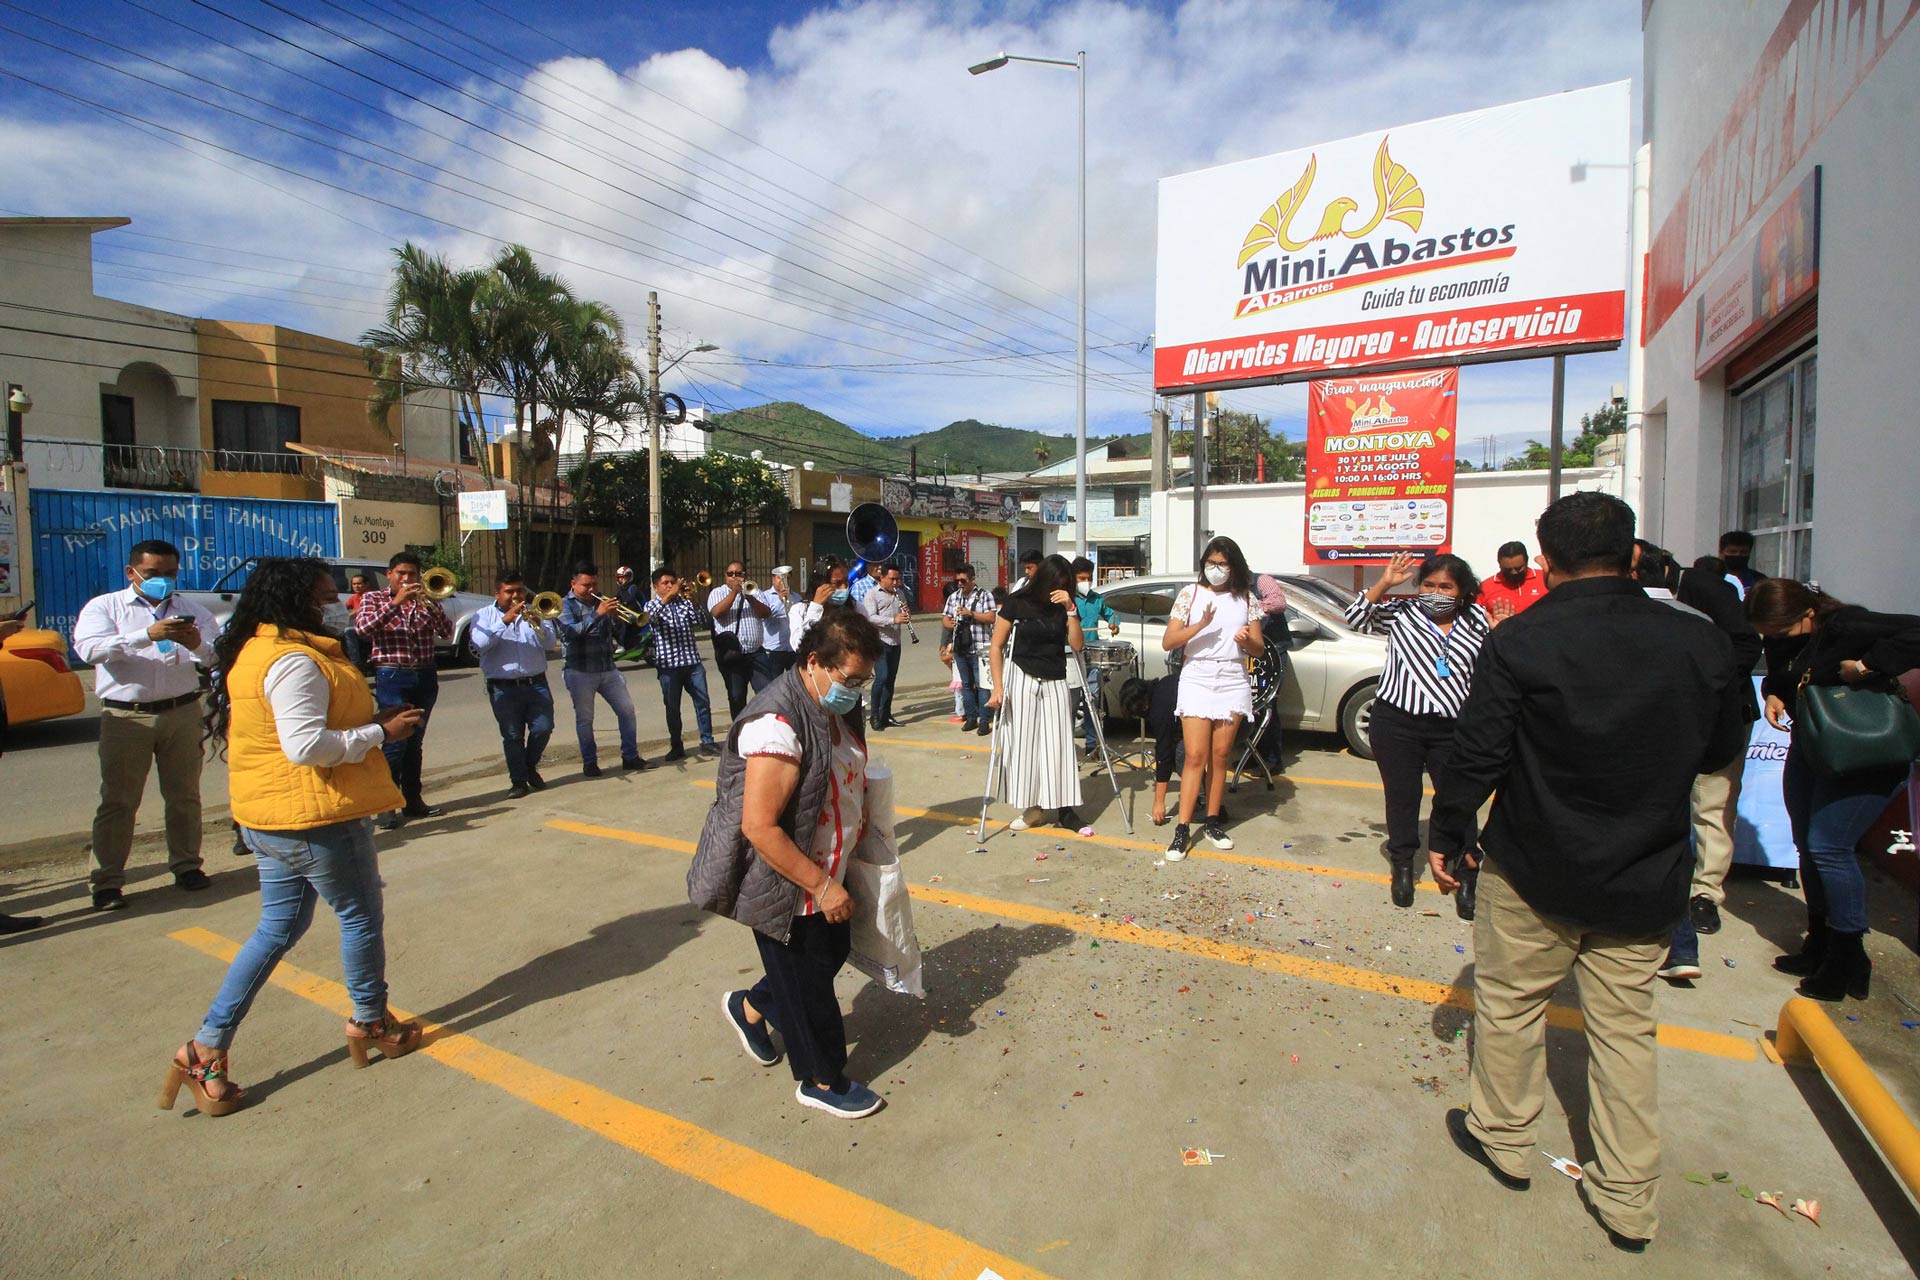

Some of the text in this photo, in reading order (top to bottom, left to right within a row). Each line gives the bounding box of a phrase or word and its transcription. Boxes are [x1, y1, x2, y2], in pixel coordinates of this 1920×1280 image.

[1240, 282, 1334, 315] Abarrotes
[1361, 272, 1510, 311] Cuida tu economía
[1183, 340, 1290, 376] Abarrotes
[1292, 331, 1395, 365] Mayoreo
[1412, 304, 1582, 350] Autoservicio
[1325, 431, 1434, 452] MONTOYA
[1338, 453, 1420, 465] 30 Y 31 DE JULIO
[1361, 464, 1374, 472] DE
[1376, 462, 1420, 471] AGOSTO
[1334, 475, 1360, 483] 10:00
[1373, 473, 1399, 482] 16:00
[1401, 472, 1422, 480] HRS
[353, 515, 395, 530] Av. Montoya
[227, 506, 324, 557] FAMILIAR
[362, 530, 386, 544] 309
[184, 536, 216, 551] DE
